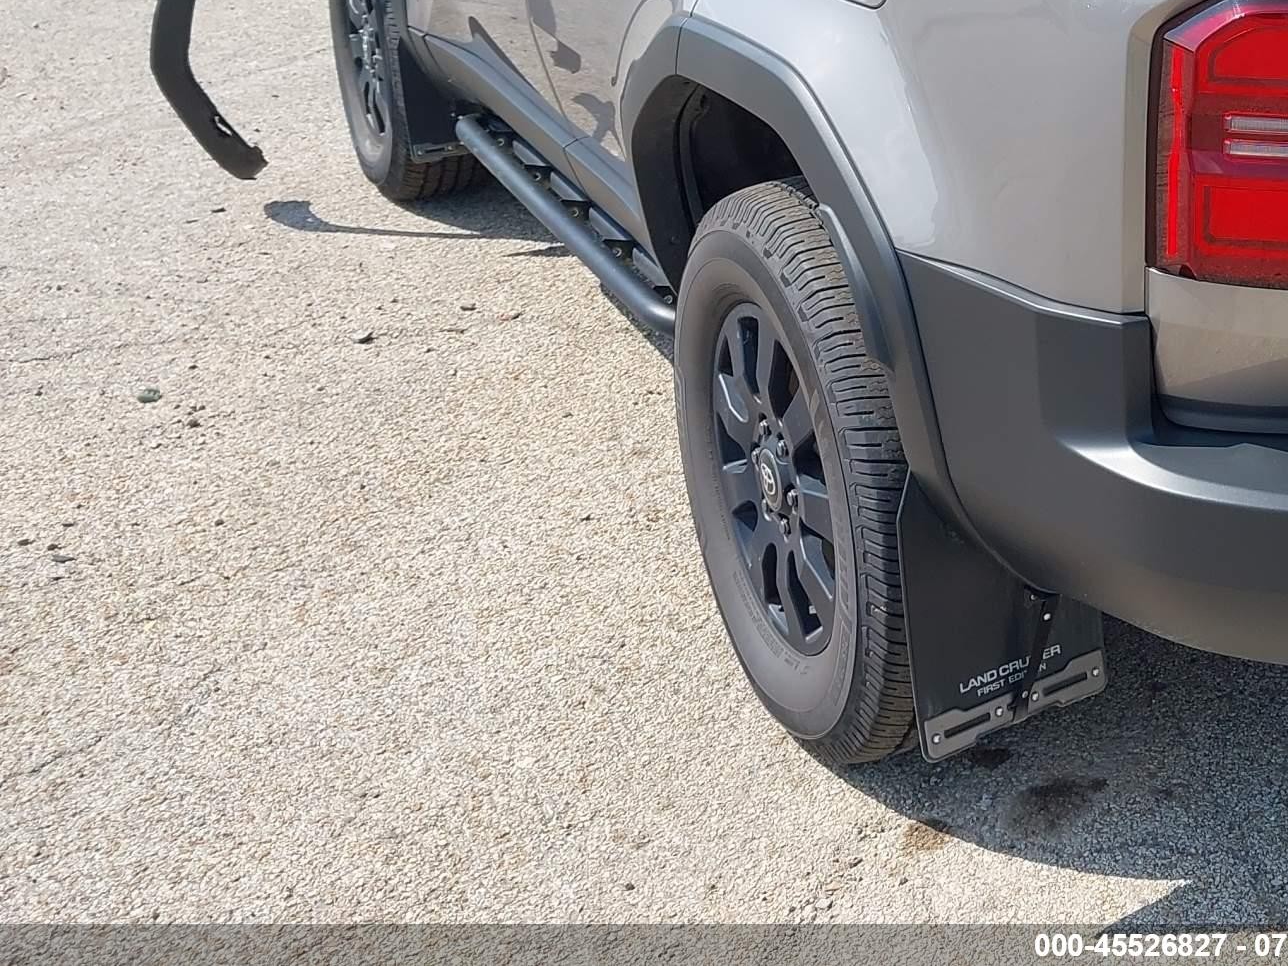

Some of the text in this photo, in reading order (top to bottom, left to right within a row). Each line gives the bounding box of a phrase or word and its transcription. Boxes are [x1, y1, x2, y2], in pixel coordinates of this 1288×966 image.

[959, 644, 1061, 694] LAND CRUER
[977, 662, 1047, 697] FIRST EDIN
